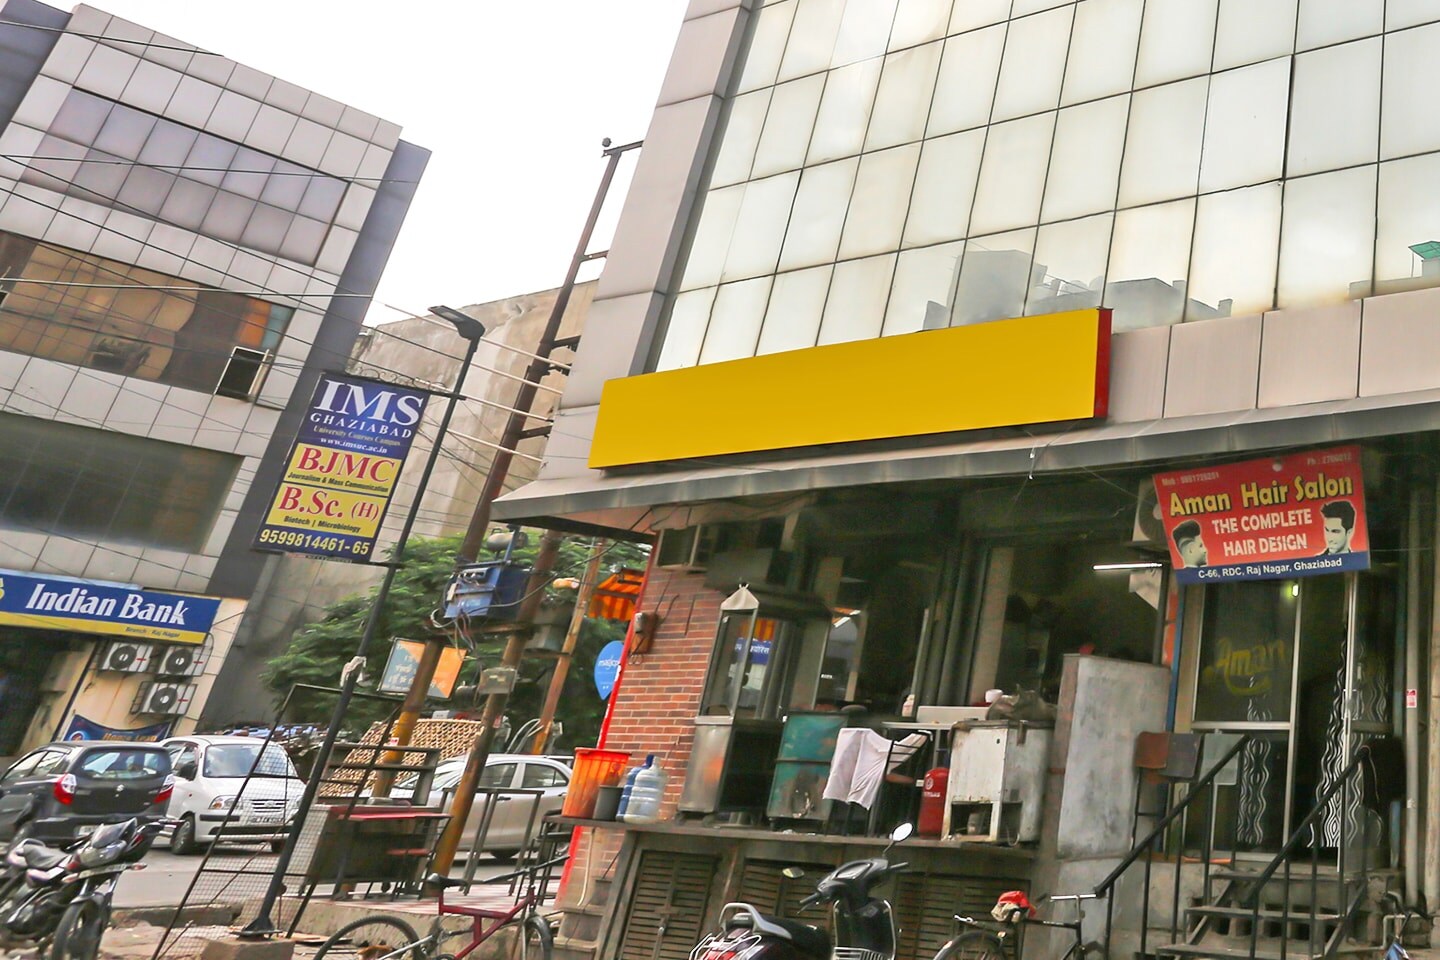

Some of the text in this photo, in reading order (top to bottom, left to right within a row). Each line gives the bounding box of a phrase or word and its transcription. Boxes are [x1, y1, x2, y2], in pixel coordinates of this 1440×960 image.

[313, 380, 424, 426] IMS
[310, 412, 412, 439] GHAZIABAD
[296, 447, 395, 482] BJMC
[287, 472, 321, 483] Journalism
[328, 478, 344, 487] Mass
[344, 481, 389, 493] Communication
[1170, 472, 1353, 517] Aman Hair Salon
[278, 486, 380, 522] B.Sc. (H)
[283, 515, 311, 526] Biotech
[317, 520, 361, 533] Microbiology
[1211, 508, 1313, 535] THE COMPLETE
[1223, 533, 1308, 557] HAIR DESIGN
[1198, 557, 1343, 579] C-66, RDC, Raj Nagar, Ghaziabad
[25, 583, 190, 626] Indian Bank
